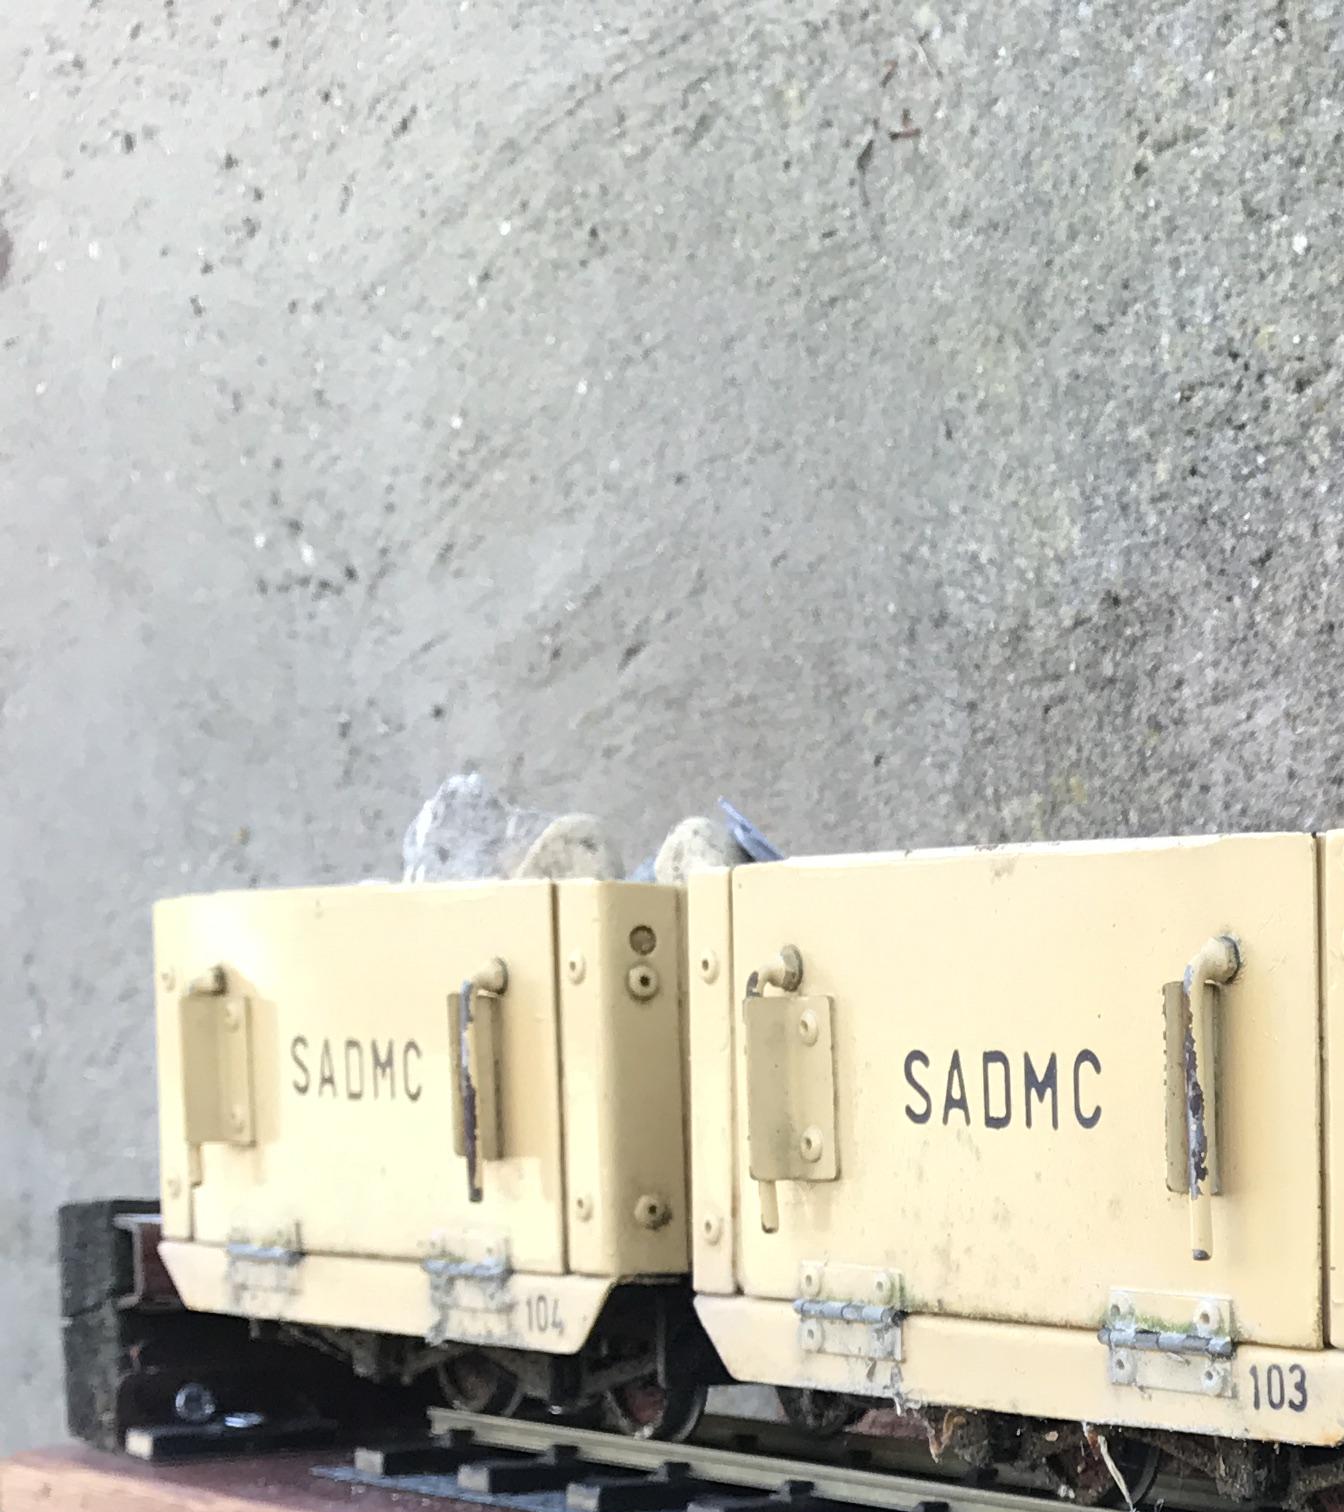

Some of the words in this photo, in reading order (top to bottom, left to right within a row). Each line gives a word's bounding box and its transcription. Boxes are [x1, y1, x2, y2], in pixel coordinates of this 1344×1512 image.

[291, 1034, 422, 1103] SADMC
[903, 1049, 1103, 1130] SADMC
[526, 1294, 566, 1337] 104
[1249, 1363, 1308, 1413] 103
